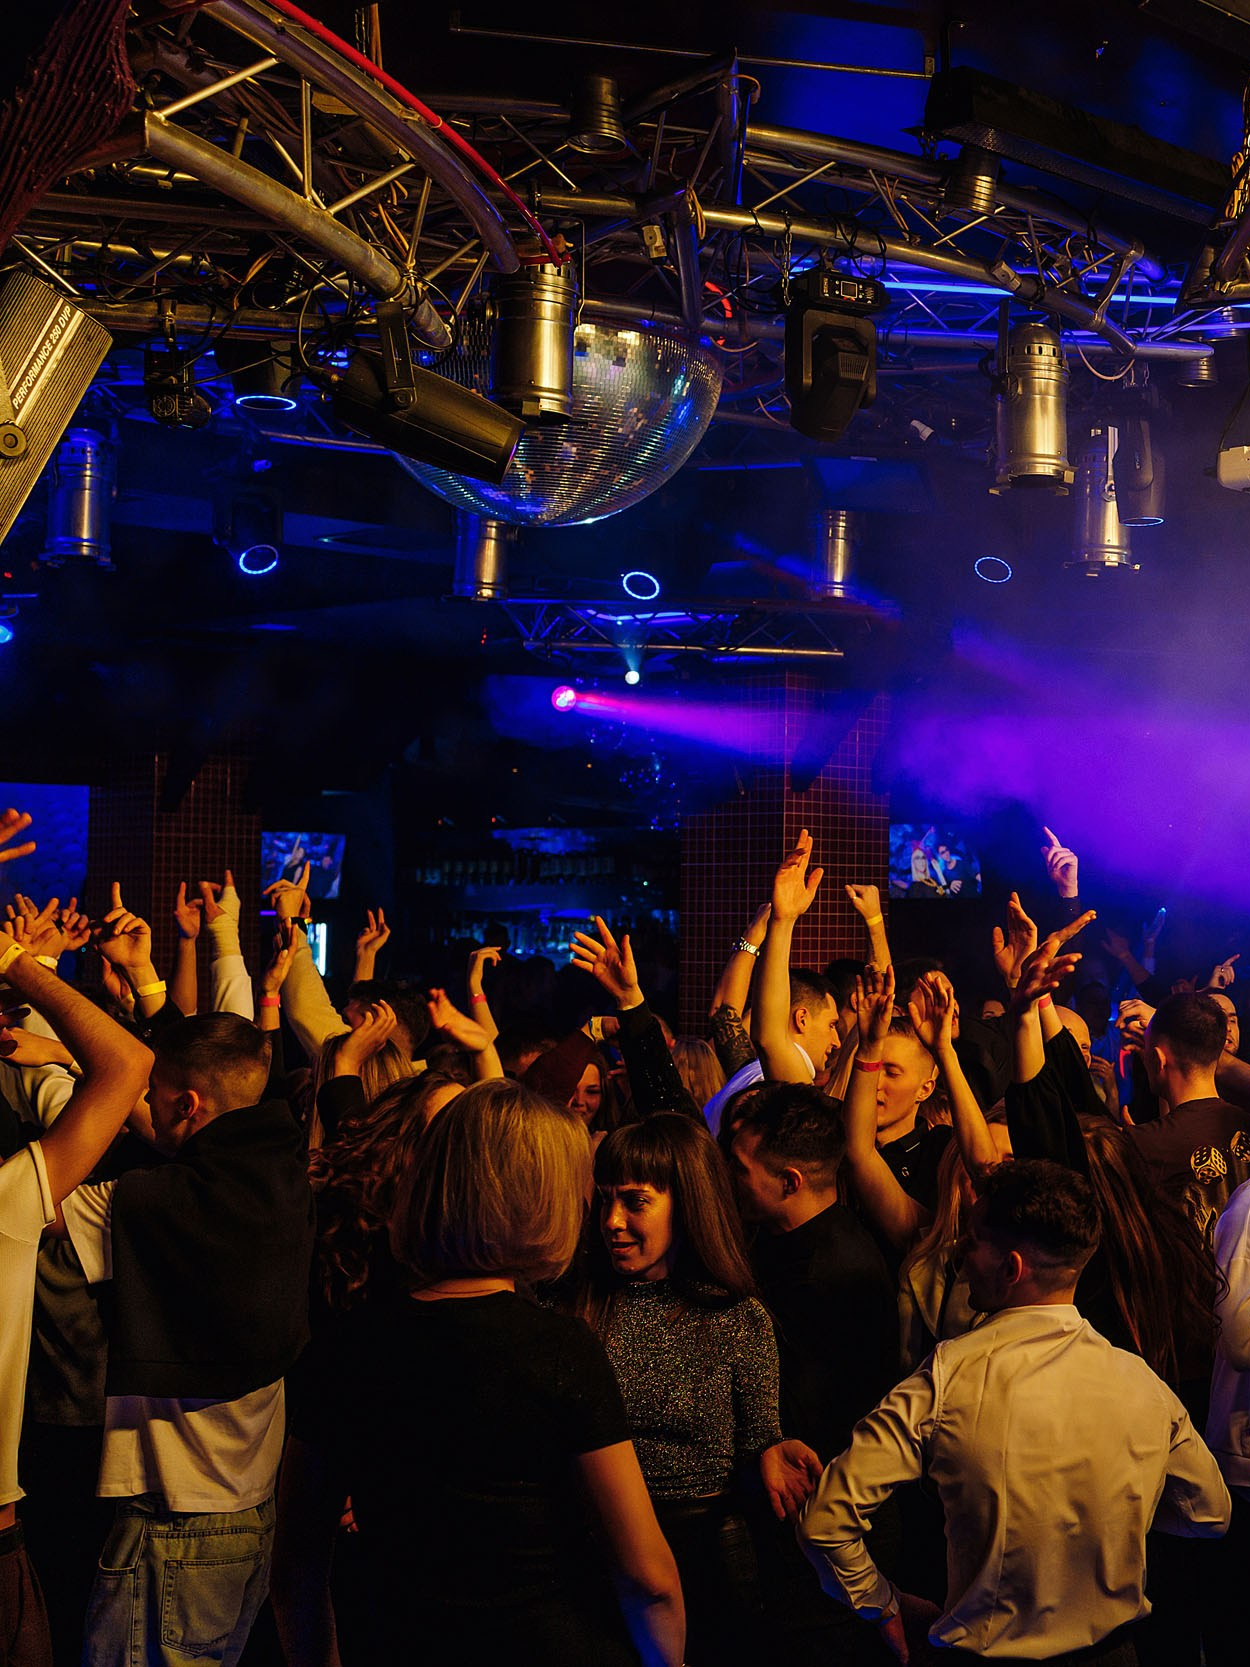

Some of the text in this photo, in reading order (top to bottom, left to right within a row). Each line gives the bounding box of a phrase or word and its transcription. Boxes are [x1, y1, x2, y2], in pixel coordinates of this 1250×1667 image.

[12, 305, 72, 410] PERFORMANCE 250 DVP
